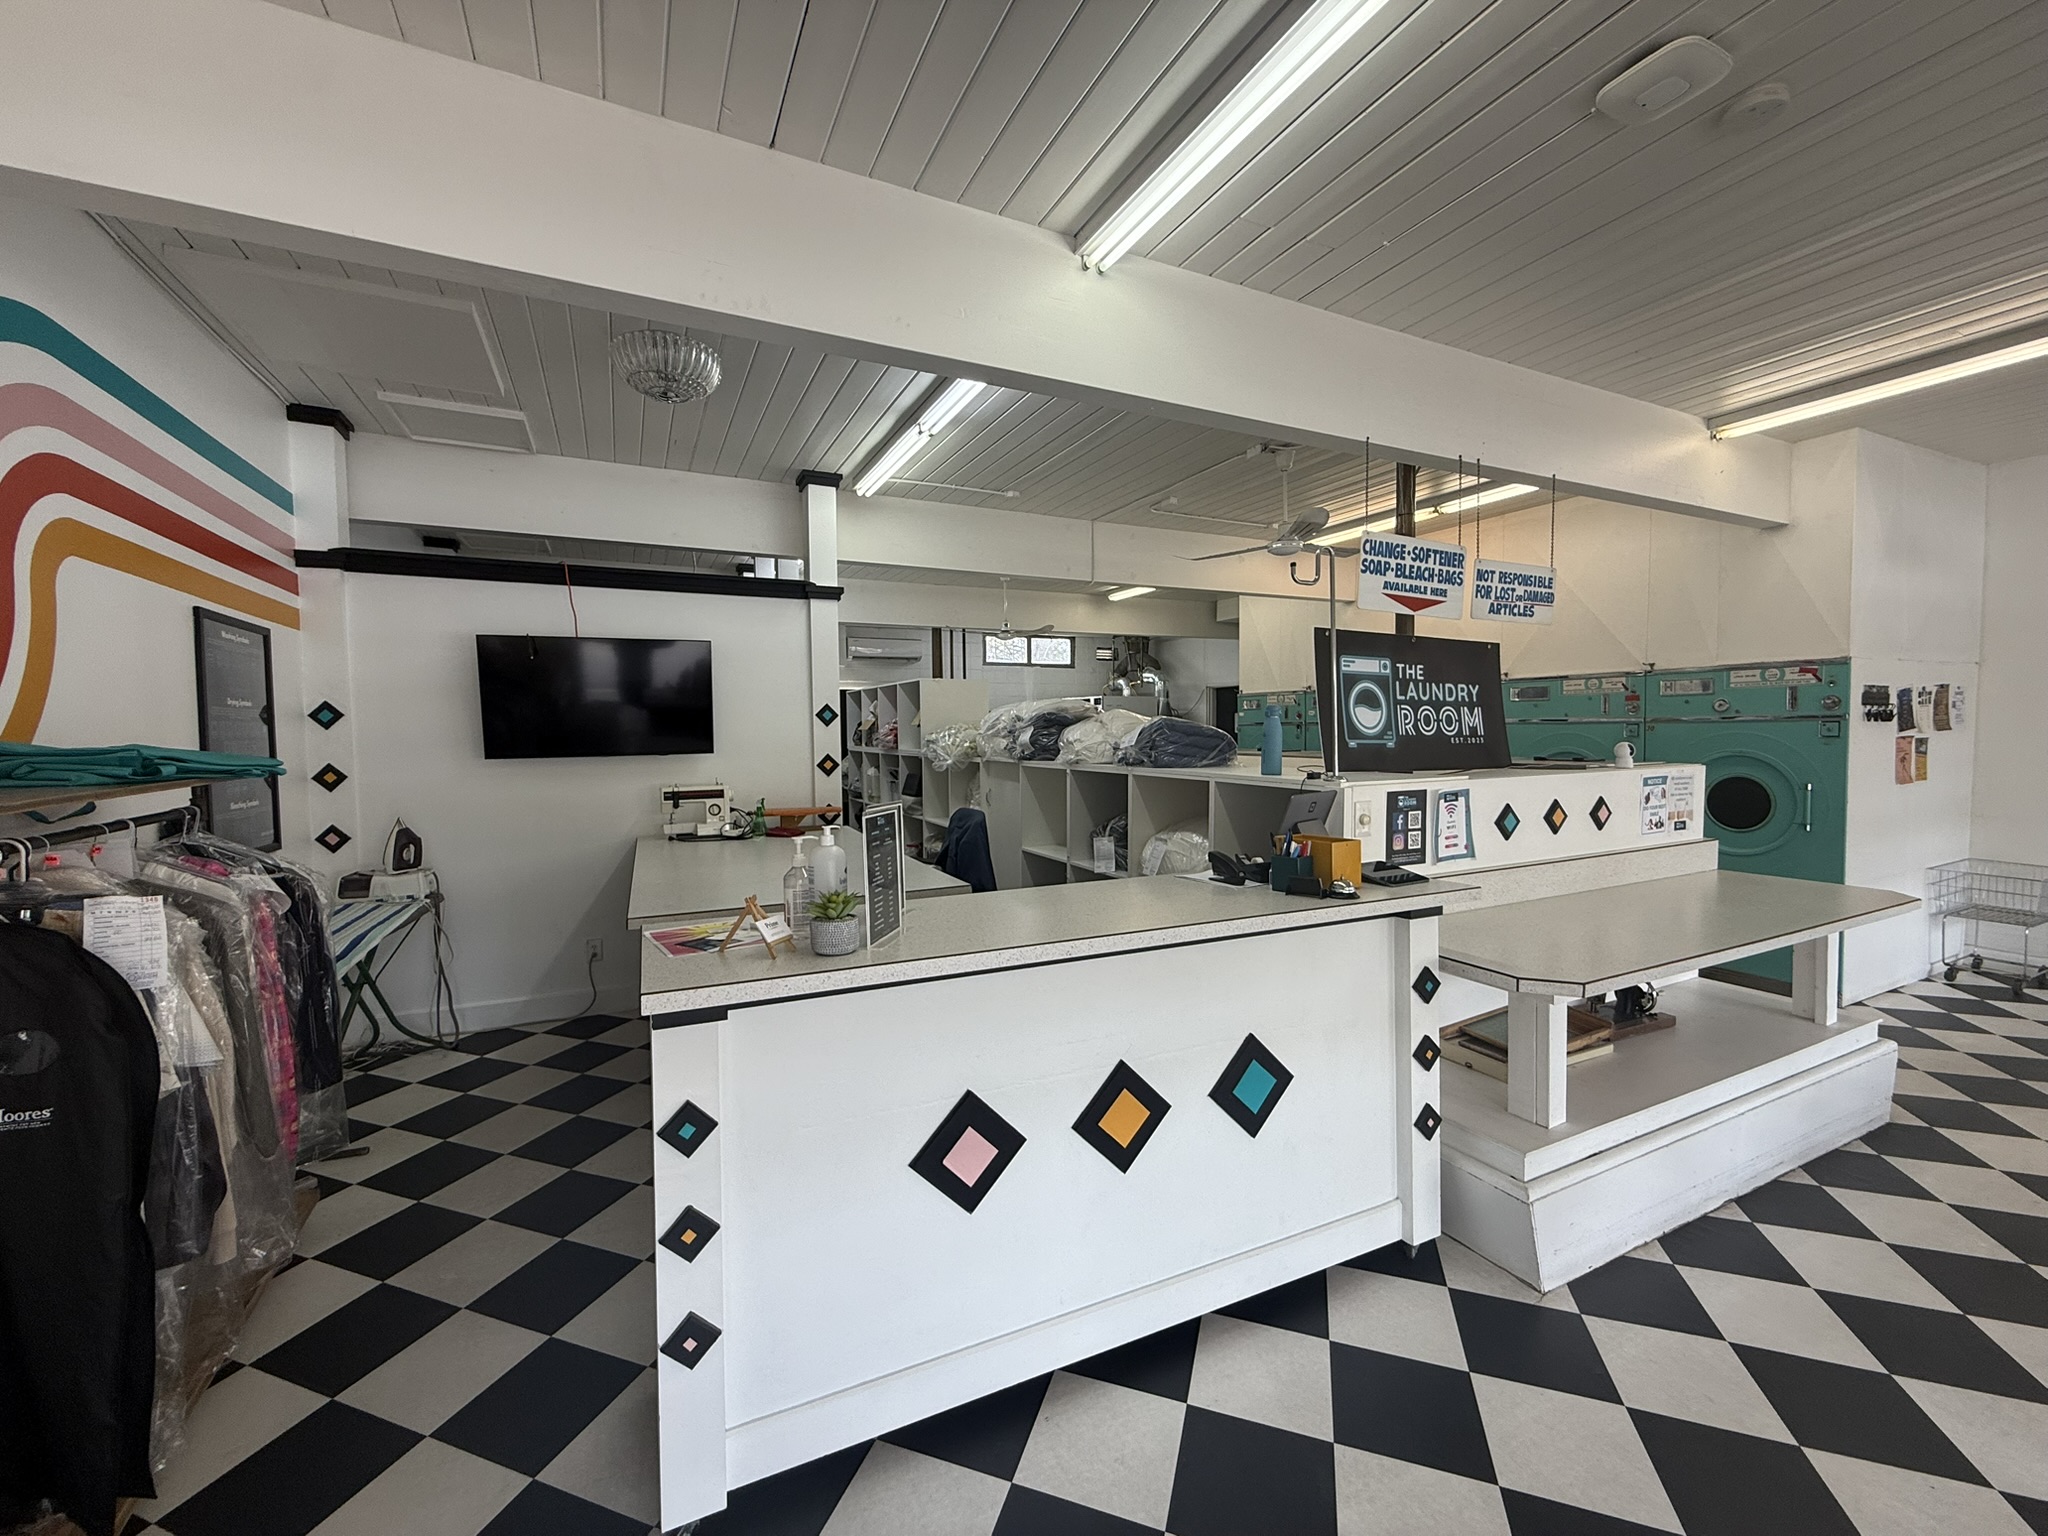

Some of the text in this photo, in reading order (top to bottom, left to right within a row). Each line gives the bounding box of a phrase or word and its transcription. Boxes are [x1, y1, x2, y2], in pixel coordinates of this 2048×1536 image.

[1362, 538, 1465, 569] CHANGE SOFTENER
[1360, 557, 1464, 587] SOAP BLEACH BAGS
[1476, 568, 1554, 590] NOT RESPONSIBLE
[1382, 580, 1448, 598] AVAILABLE HERE
[1475, 583, 1493, 600] FOR
[1494, 585, 1516, 602] LOST
[1523, 589, 1555, 604] DAMAGED
[1488, 602, 1535, 617] ARTICLES
[1396, 663, 1424, 680] THE
[1396, 681, 1479, 702] LAUNDRY
[1397, 704, 1485, 736] ROOM
